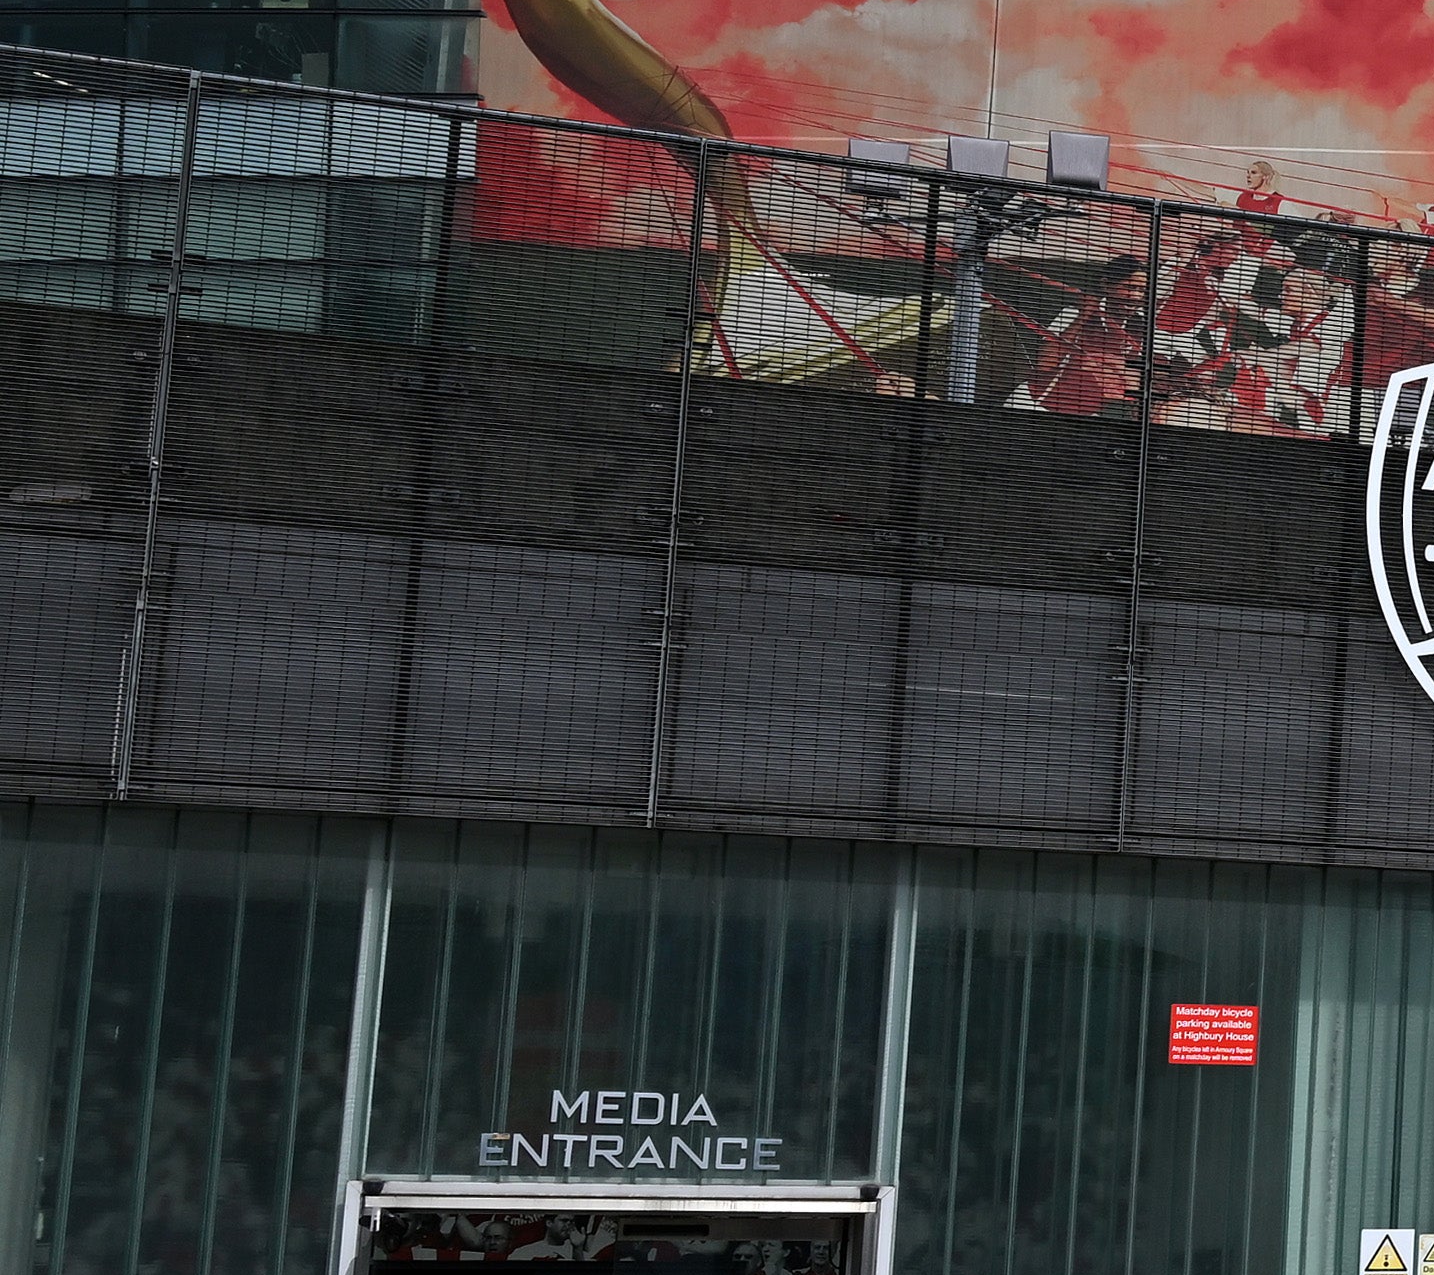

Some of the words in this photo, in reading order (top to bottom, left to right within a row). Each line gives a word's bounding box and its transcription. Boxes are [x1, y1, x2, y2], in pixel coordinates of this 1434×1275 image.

[1176, 1007, 1220, 1018] Matchday
[1221, 1007, 1254, 1019] bicycle
[1176, 1019, 1210, 1030] parking
[1212, 1019, 1252, 1029] available
[1172, 1032, 1182, 1040] at
[1184, 1031, 1224, 1042] Highbury
[1225, 1032, 1255, 1041] House
[550, 1089, 718, 1127] MEDIA
[478, 1133, 783, 1171] ENTRANCE
